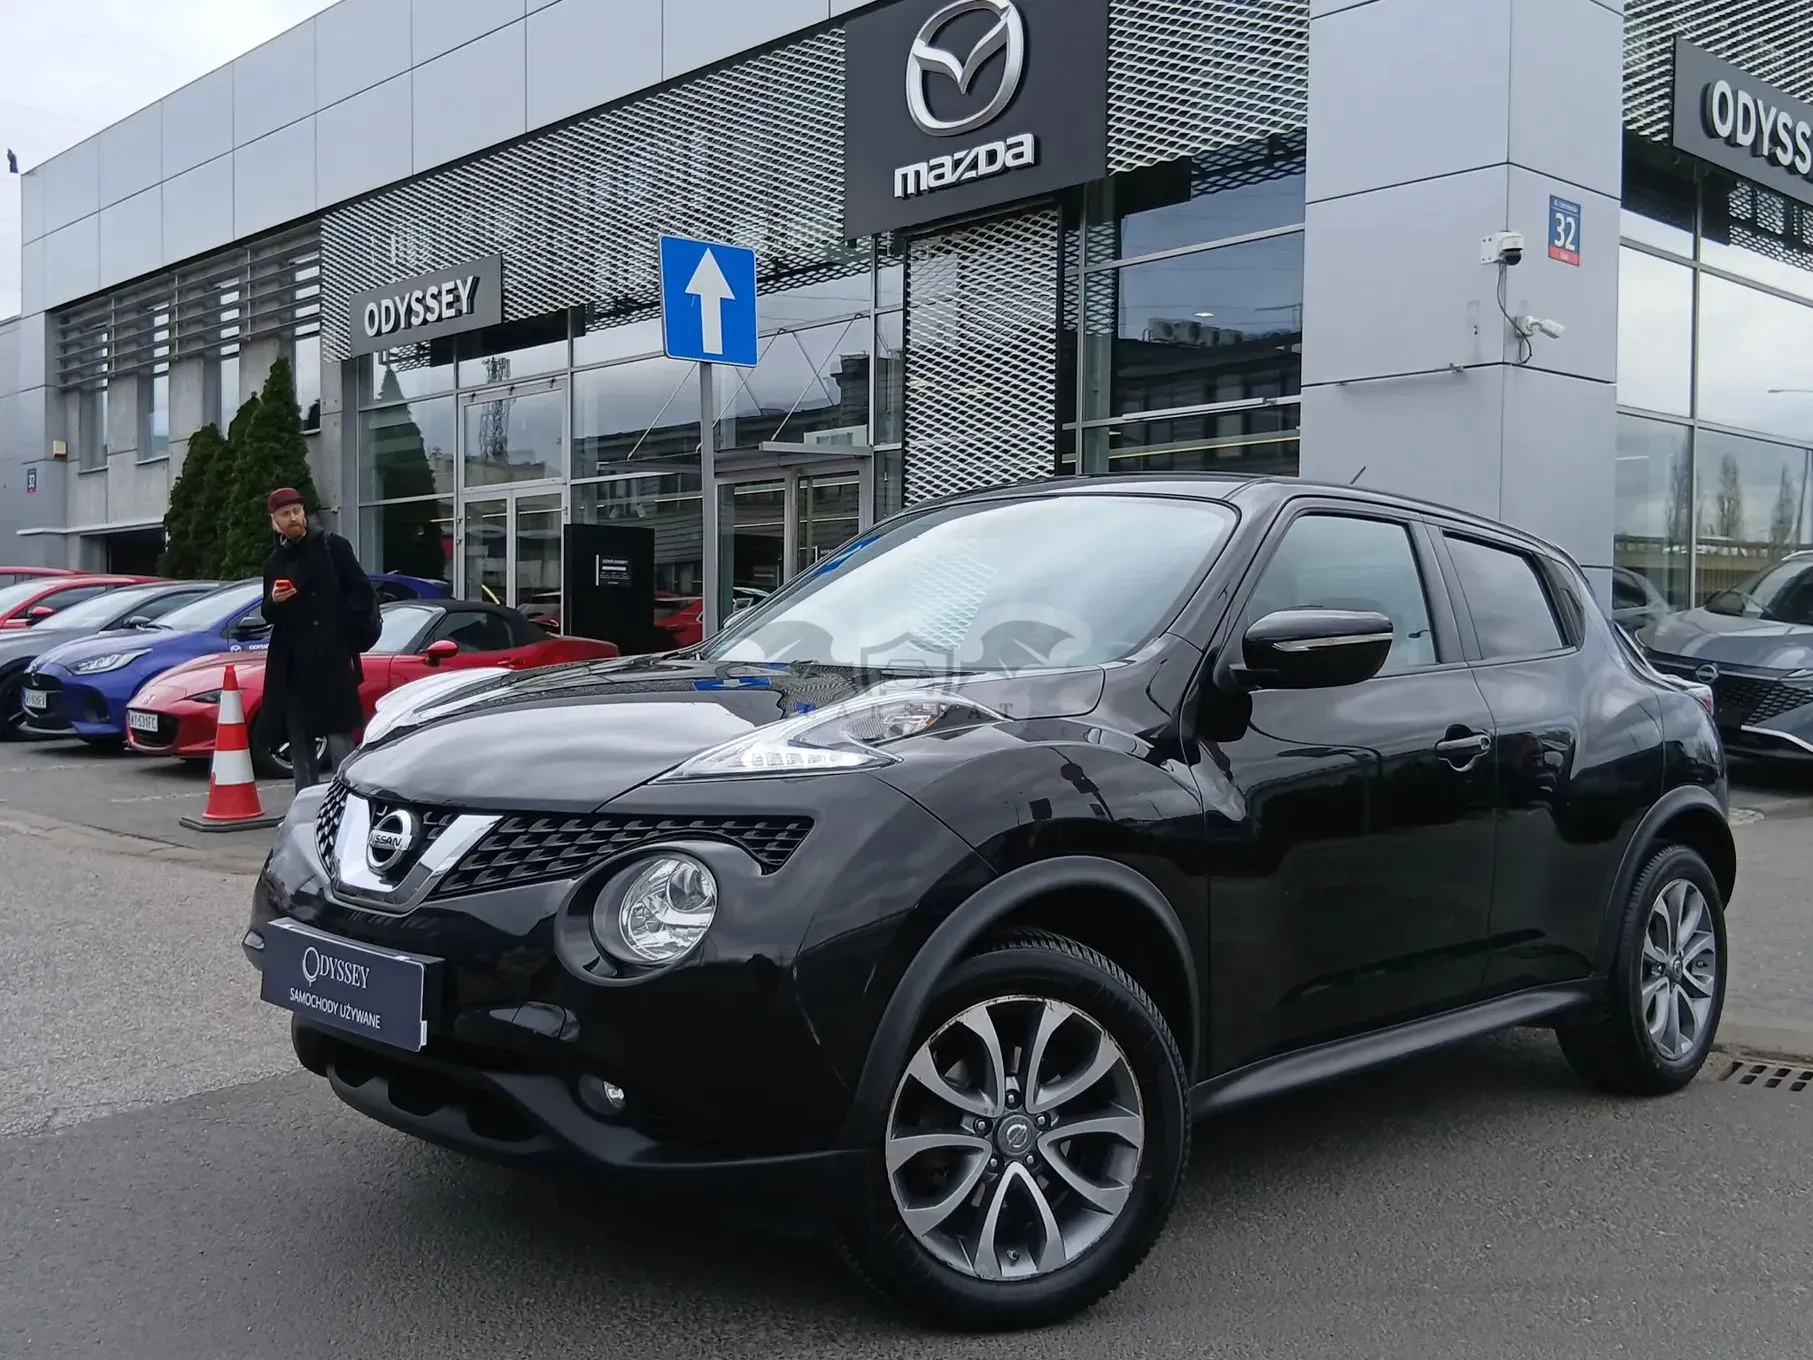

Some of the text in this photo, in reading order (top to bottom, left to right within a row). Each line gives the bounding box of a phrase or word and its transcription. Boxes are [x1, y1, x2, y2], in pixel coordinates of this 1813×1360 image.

[1553, 212, 1576, 252] 32
[364, 275, 477, 337] ODYSSEY
[302, 946, 370, 989] ODYSSEY
[289, 987, 381, 1029] SAMOCHODY UŻYWANE
